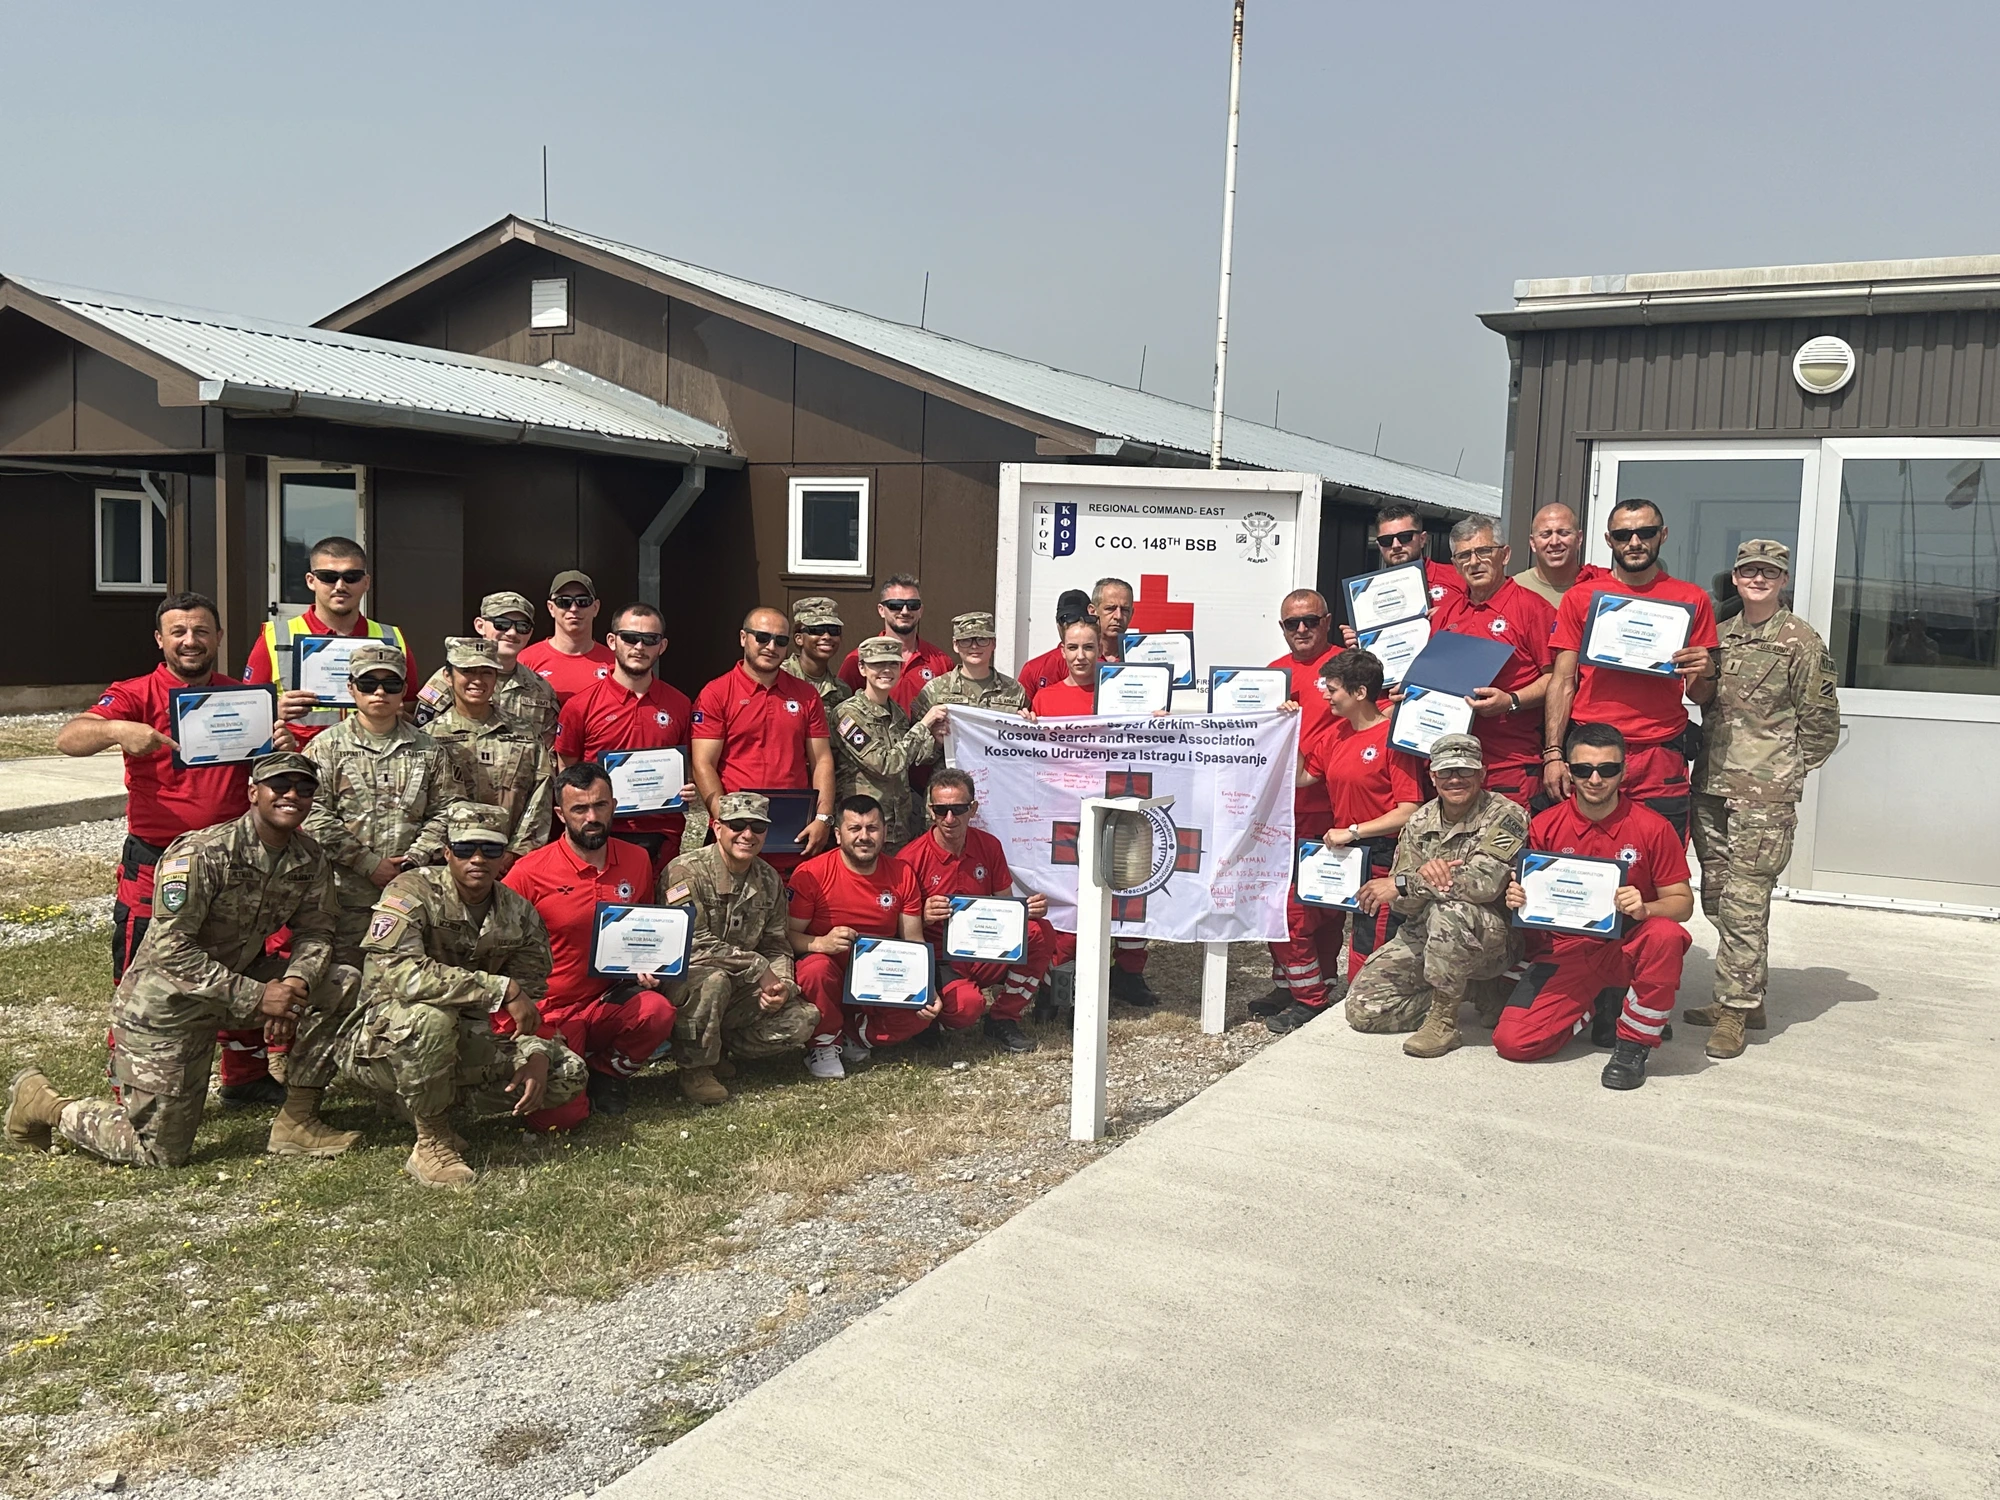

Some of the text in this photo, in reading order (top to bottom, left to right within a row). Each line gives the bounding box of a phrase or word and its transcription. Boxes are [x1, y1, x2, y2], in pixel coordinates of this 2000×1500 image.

[1088, 503, 1226, 517] REGIONAL COMMAND- EAST
[1039, 505, 1049, 551] KFOR
[1095, 536, 1217, 552] C CO. 148TH BSB
[1772, 645, 1790, 653] ARMY
[1147, 718, 1259, 731] Kërkim-Shpëtim
[997, 729, 1256, 747] Kosova Search and Rescue Association
[984, 745, 1268, 768] Kosovcko Udruženje za Istragu i Spasavanje
[1149, 855, 1174, 888] Association
